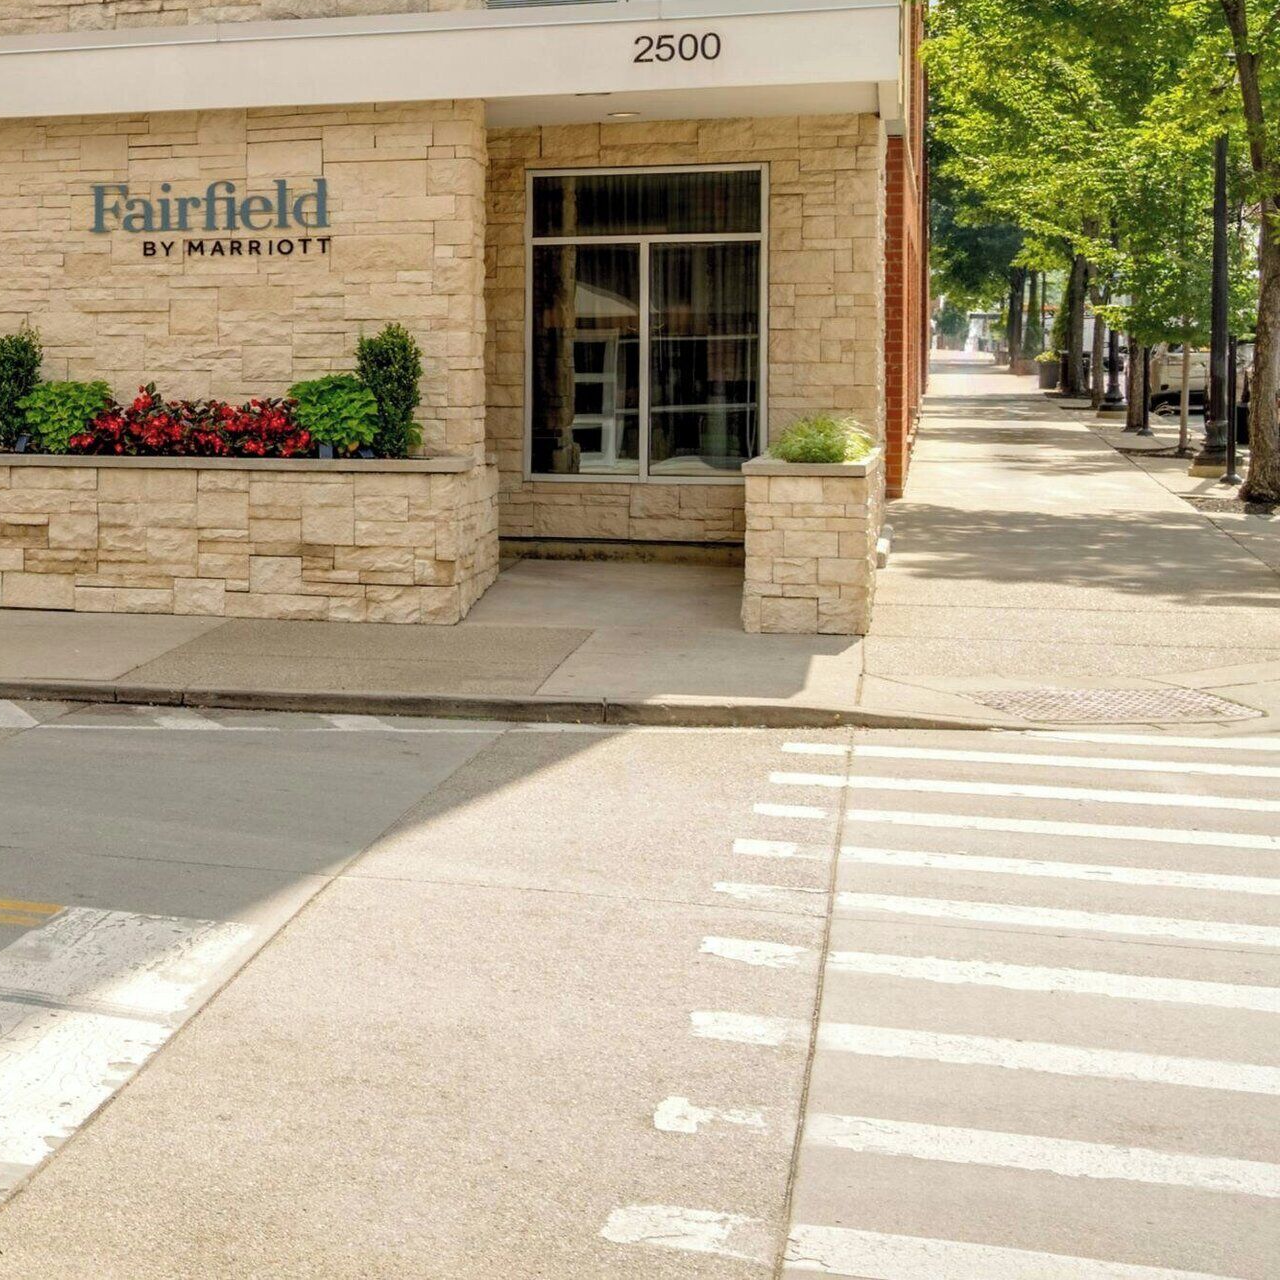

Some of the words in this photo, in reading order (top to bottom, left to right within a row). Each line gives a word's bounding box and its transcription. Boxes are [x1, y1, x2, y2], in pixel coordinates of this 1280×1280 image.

[633, 32, 721, 63] 2500
[90, 178, 331, 233] Fairfield
[142, 241, 175, 257] BY
[188, 236, 331, 256] MARRIOTT
